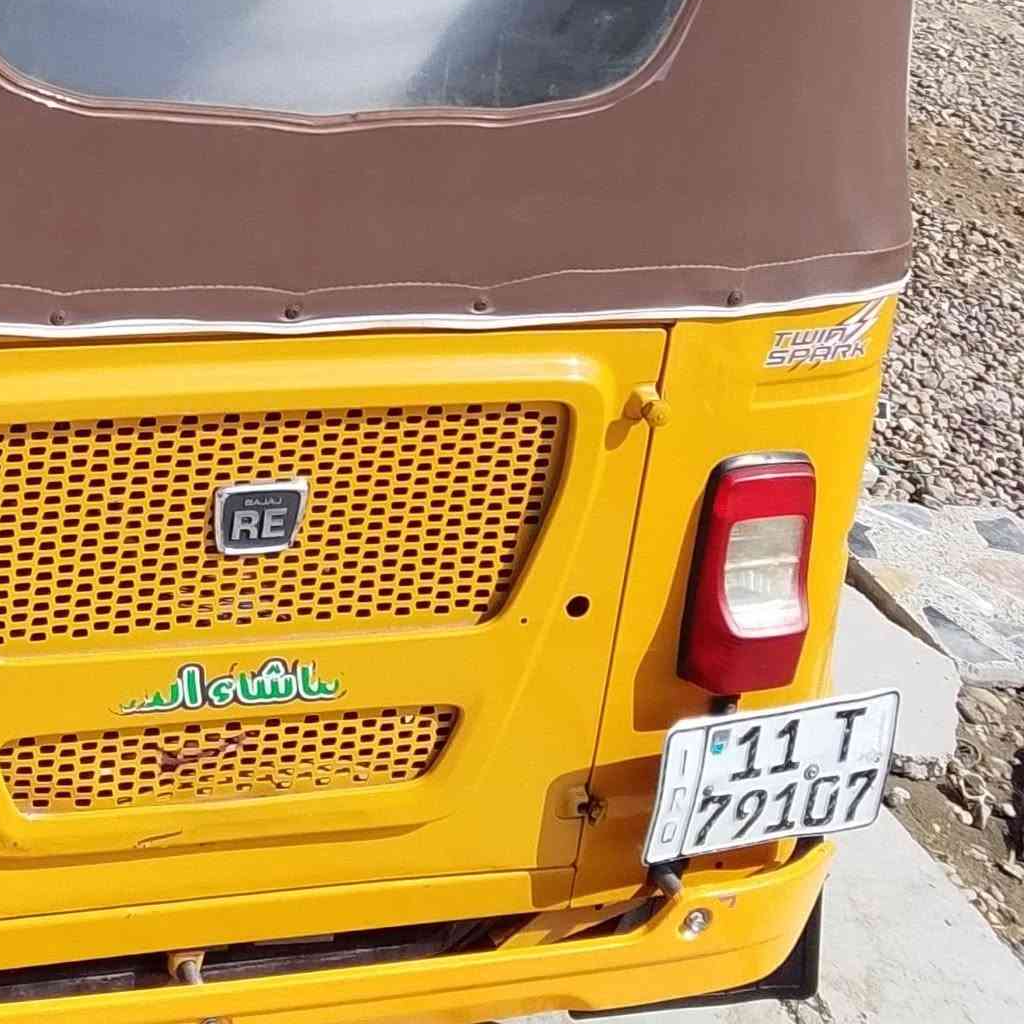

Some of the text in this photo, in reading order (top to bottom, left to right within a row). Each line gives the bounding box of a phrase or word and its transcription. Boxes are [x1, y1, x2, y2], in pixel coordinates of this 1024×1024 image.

[775, 326, 848, 347] TWIN
[766, 342, 865, 366] SPARK
[231, 507, 288, 541] RE
[728, 707, 868, 783] 11 T
[693, 768, 879, 847] 79107
